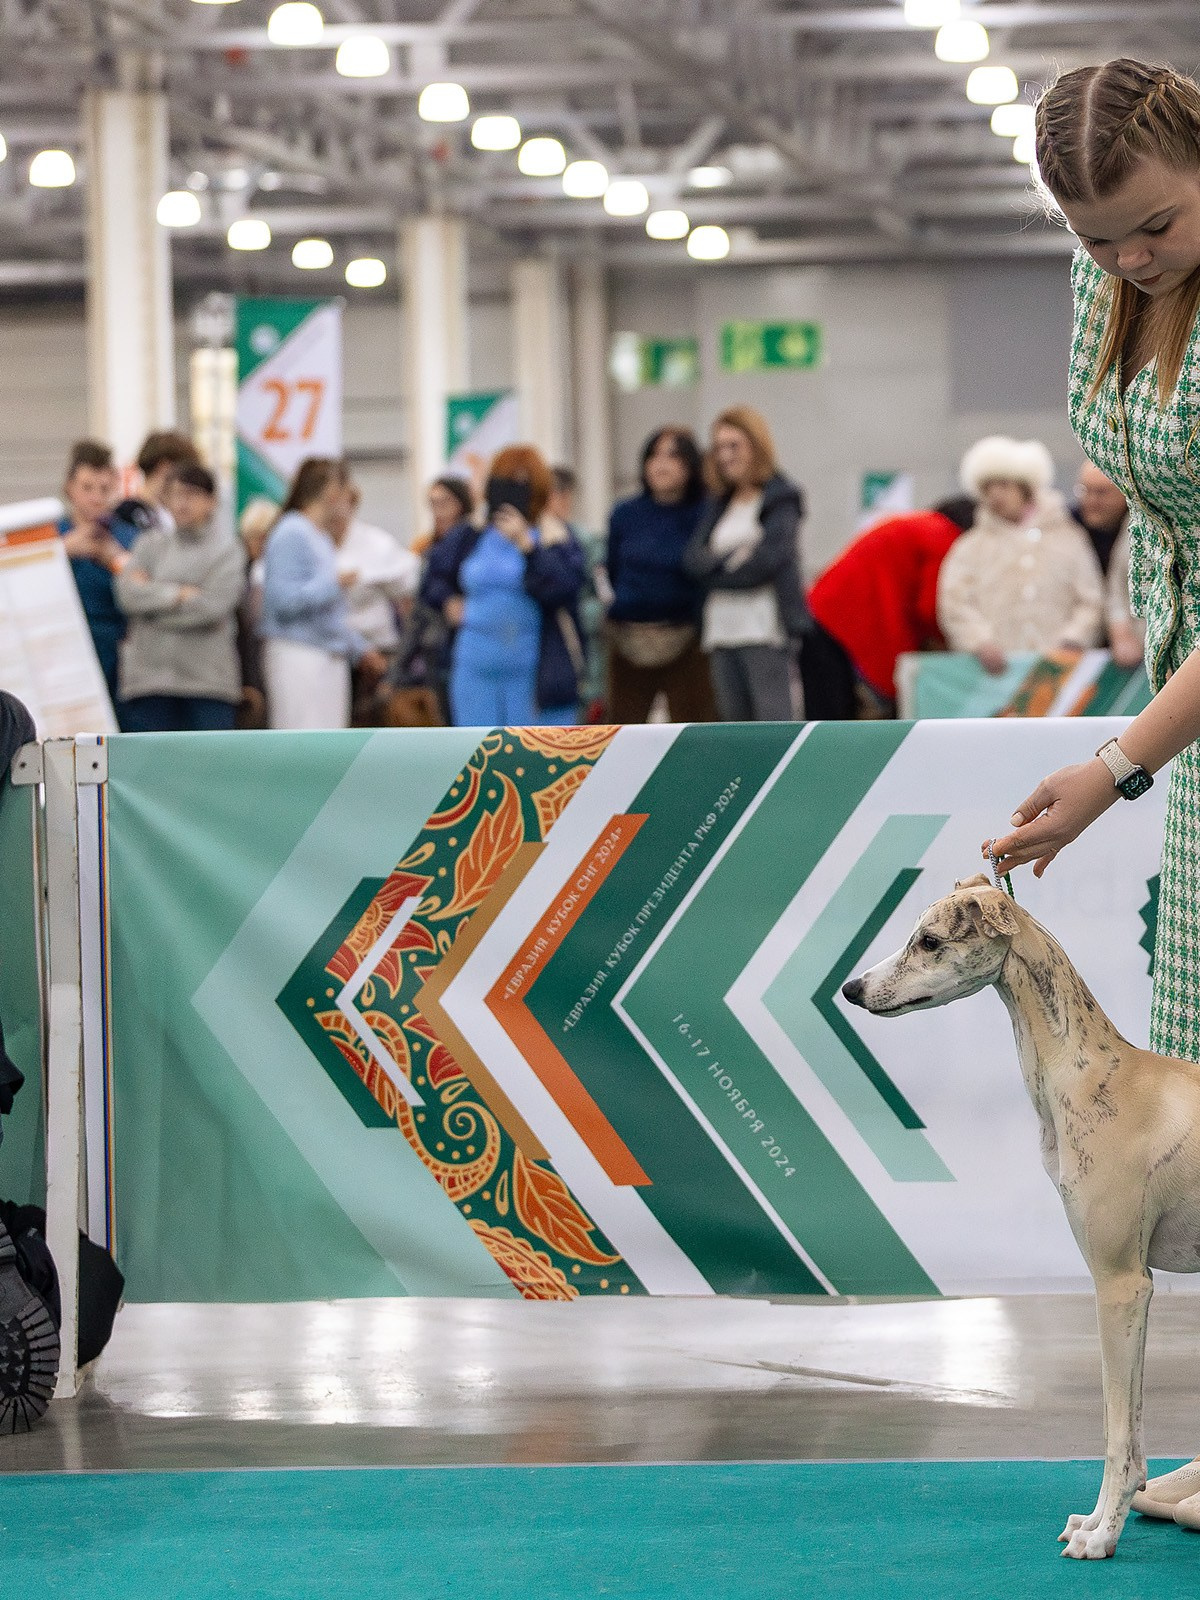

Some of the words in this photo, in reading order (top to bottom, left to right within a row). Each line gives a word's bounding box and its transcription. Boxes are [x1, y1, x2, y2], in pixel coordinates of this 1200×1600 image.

[261, 376, 325, 441] 27
[546, 889, 581, 935] КУБОК
[577, 858, 600, 892] СНГ
[605, 921, 642, 970] КУБОК
[636, 840, 701, 926] ПРЕЗИДЕНТА
[696, 808, 719, 842] РКФ
[672, 1013, 711, 1058] 16-17
[707, 1061, 766, 1134] НОЯБРЯ
[761, 1135, 797, 1178] 2024
